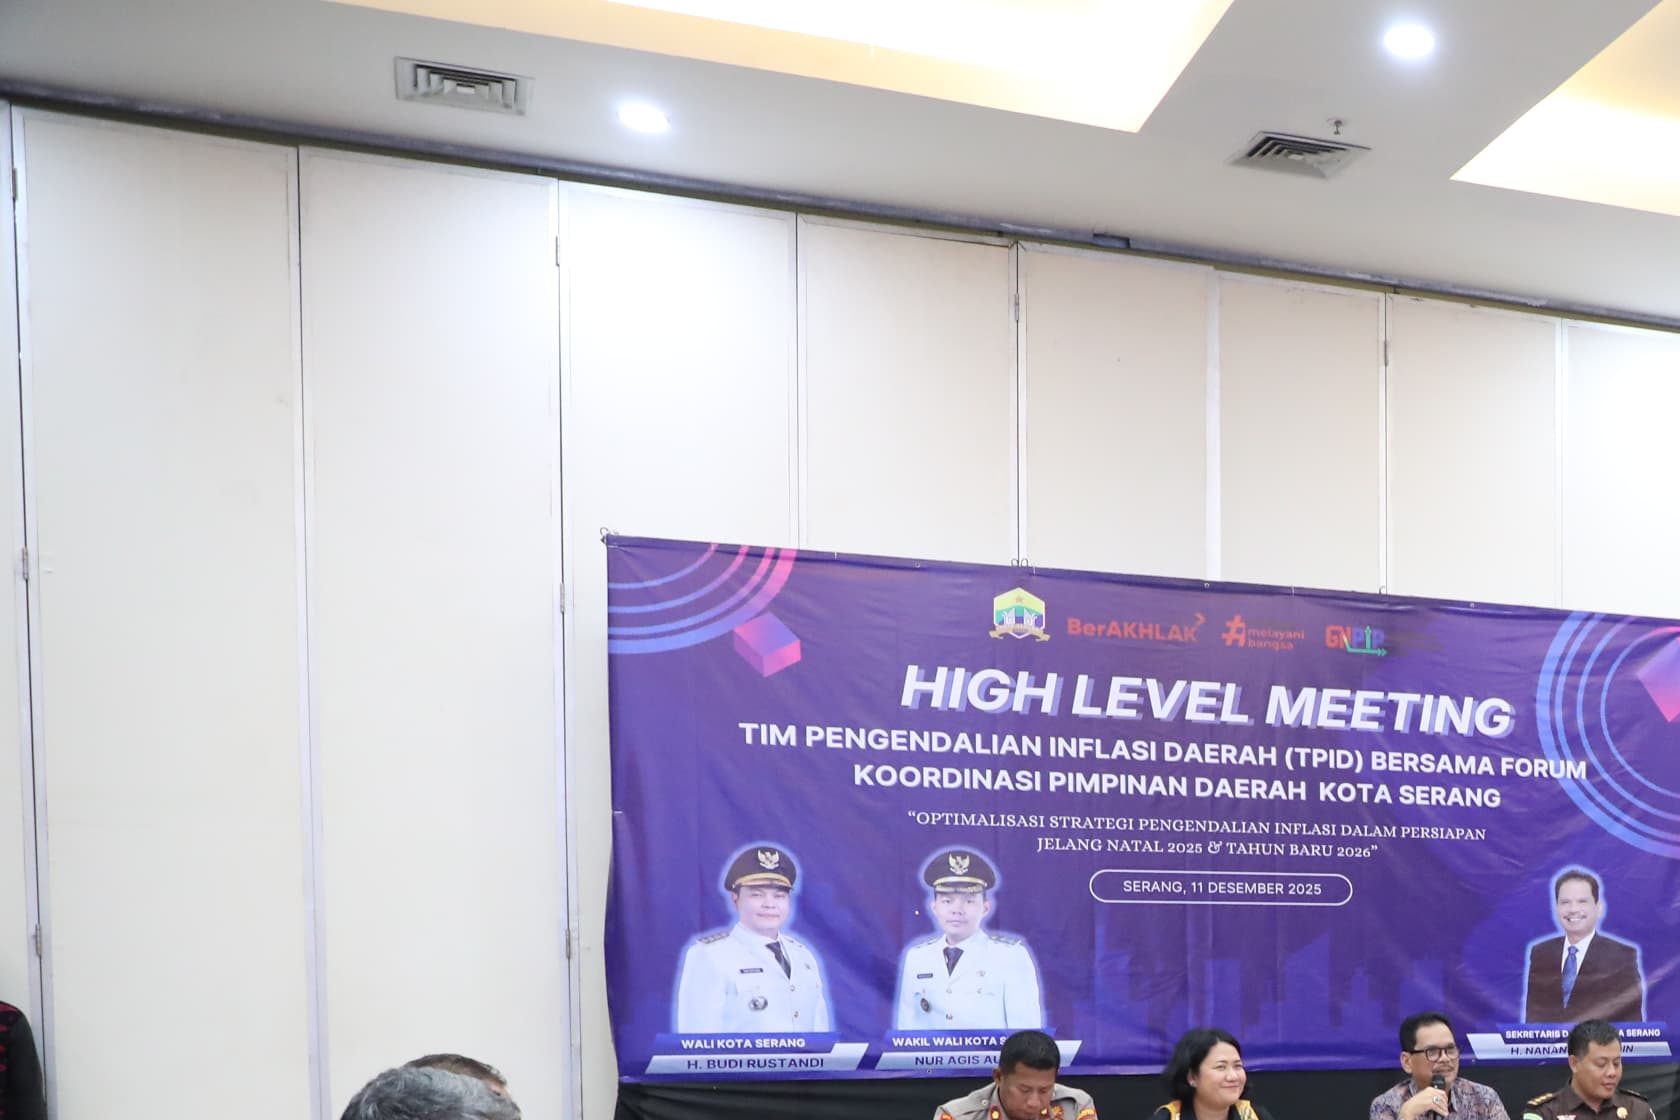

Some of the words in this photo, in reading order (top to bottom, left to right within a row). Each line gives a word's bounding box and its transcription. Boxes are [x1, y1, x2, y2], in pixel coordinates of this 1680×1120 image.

[1067, 617, 1198, 643] BerAKHLAK
[901, 665, 1057, 713] HIGH
[1072, 675, 1248, 723] LEVEL
[1266, 686, 1515, 736] MEETING
[739, 723, 796, 746] TIM
[806, 726, 1041, 756] PENGENDALIAN
[1050, 737, 1156, 760] INFLASI
[1165, 742, 1276, 765] DAERAH
[1286, 747, 1363, 773] (TPID)
[1372, 752, 1494, 775] BERSAMA
[1502, 757, 1586, 780] FORUM
[855, 765, 1040, 791] KOORDINASI
[1050, 772, 1186, 796] PIMPINAN
[1196, 778, 1305, 800] DAERAH
[1320, 782, 1392, 803] KOTA
[1400, 785, 1500, 807] SERANG
[908, 811, 1044, 827] “OPTIMALISASI
[1050, 816, 1132, 829] STRATEGI
[1139, 819, 1269, 833] PENGENDALIAN
[1275, 823, 1335, 835] INFLASI
[1342, 825, 1396, 837] DALAM
[1402, 827, 1485, 839] PERSIAPAN
[1038, 838, 1101, 852] JELANG
[1107, 840, 1163, 852] NATAL
[1168, 843, 1202, 853] 2025
[1208, 841, 1222, 853] &
[1226, 843, 1284, 855] TAHUN
[1290, 844, 1332, 856] BARU
[1338, 845, 1377, 857] 2026”
[1124, 881, 1185, 894] SERANG,
[1192, 882, 1202, 892] 11
[1209, 882, 1283, 894] DESEMBER
[1289, 884, 1321, 894] 2025
[1505, 1029, 1561, 1039] SEKRETARIS
[1626, 1028, 1661, 1037] SERANG
[681, 1039, 714, 1049] WALI
[717, 1038, 752, 1049] KOTA
[755, 1038, 806, 1048] SERANG
[892, 1036, 931, 1047] WAKIL
[932, 1036, 963, 1046] WALI
[964, 1036, 998, 1046] KOTA
[1510, 1046, 1523, 1056] H.
[1525, 1045, 1569, 1056] NANAN
[687, 1059, 703, 1070] H.
[707, 1059, 743, 1069] BUDI
[746, 1058, 824, 1069] RUSTANDI
[915, 1056, 944, 1066] NUR
[948, 1055, 980, 1065] AGIS
